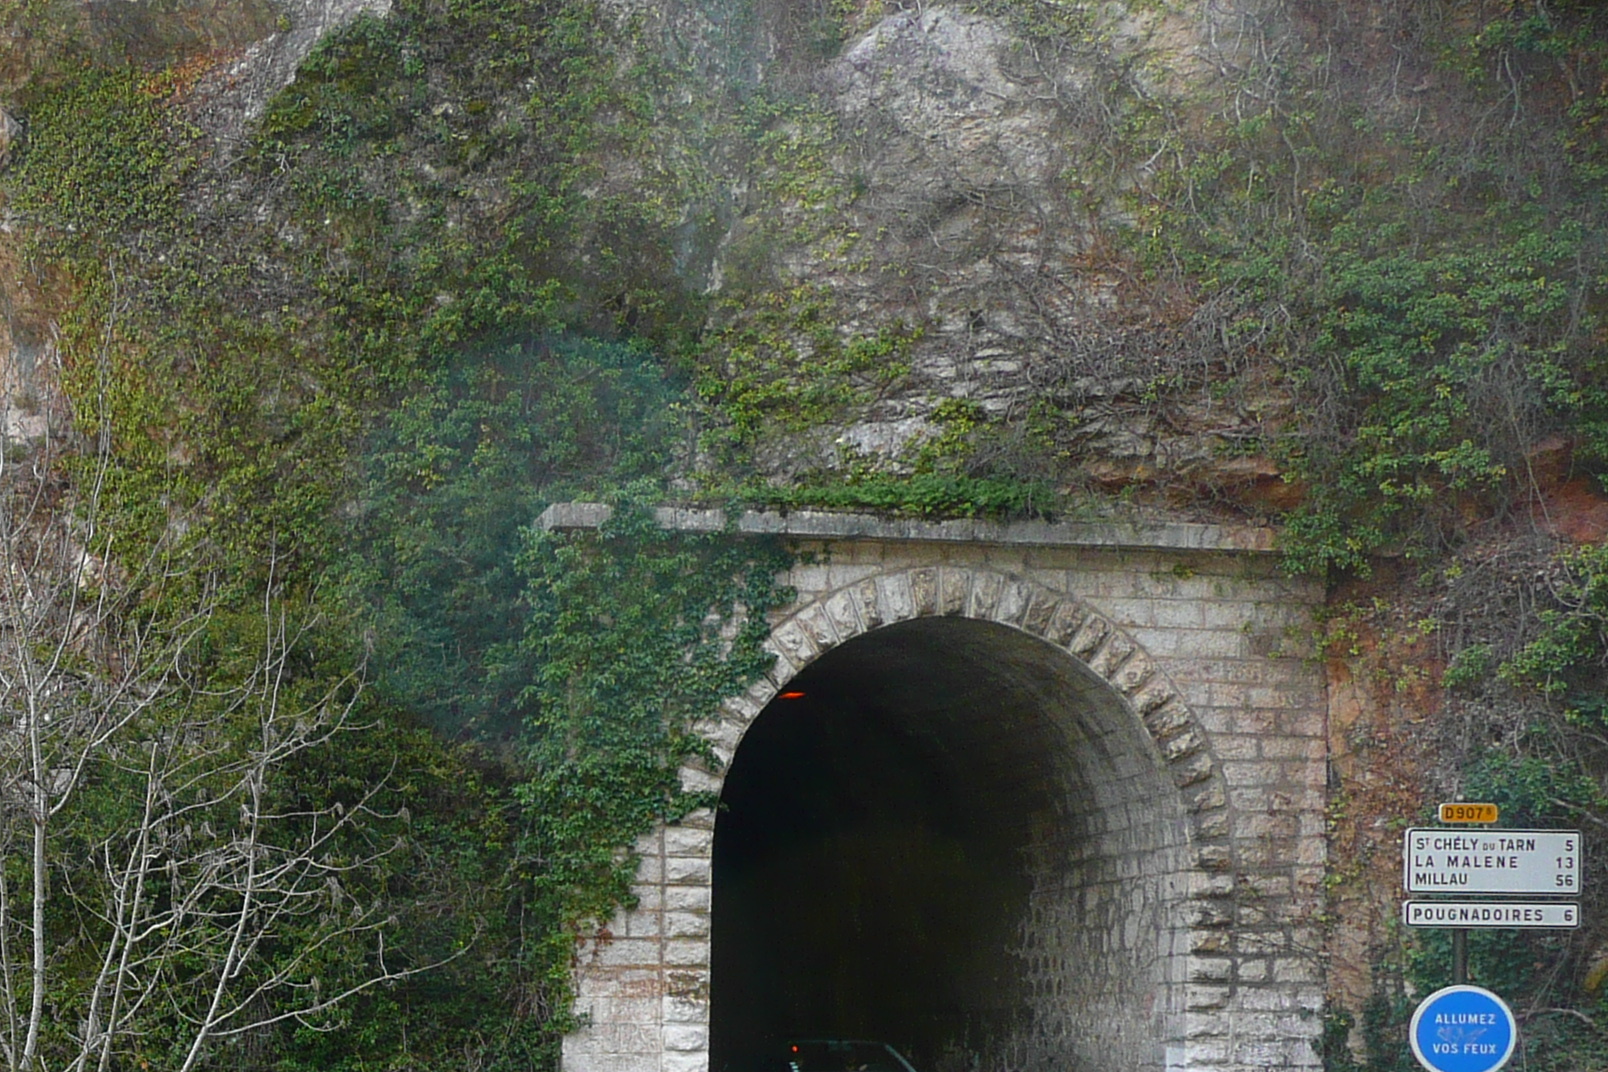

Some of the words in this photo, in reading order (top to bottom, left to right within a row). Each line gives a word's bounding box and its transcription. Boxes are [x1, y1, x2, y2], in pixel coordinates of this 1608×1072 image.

[1434, 836, 1479, 850] CHÉLY
[1483, 843, 1495, 851] DU
[1499, 838, 1536, 851] TARN
[1565, 839, 1574, 852] 5
[1415, 855, 1434, 867] LA
[1447, 855, 1518, 868] MALENE
[1556, 857, 1574, 869] 13
[1415, 872, 1468, 885] MILLAU
[1555, 874, 1574, 887] 56
[1413, 908, 1543, 922] POUGNADOIRES
[1564, 909, 1573, 922] 6
[1435, 1013, 1496, 1025] ALLUMEZ
[1433, 1043, 1459, 1054] VOS
[1463, 1044, 1497, 1055] FEUX
